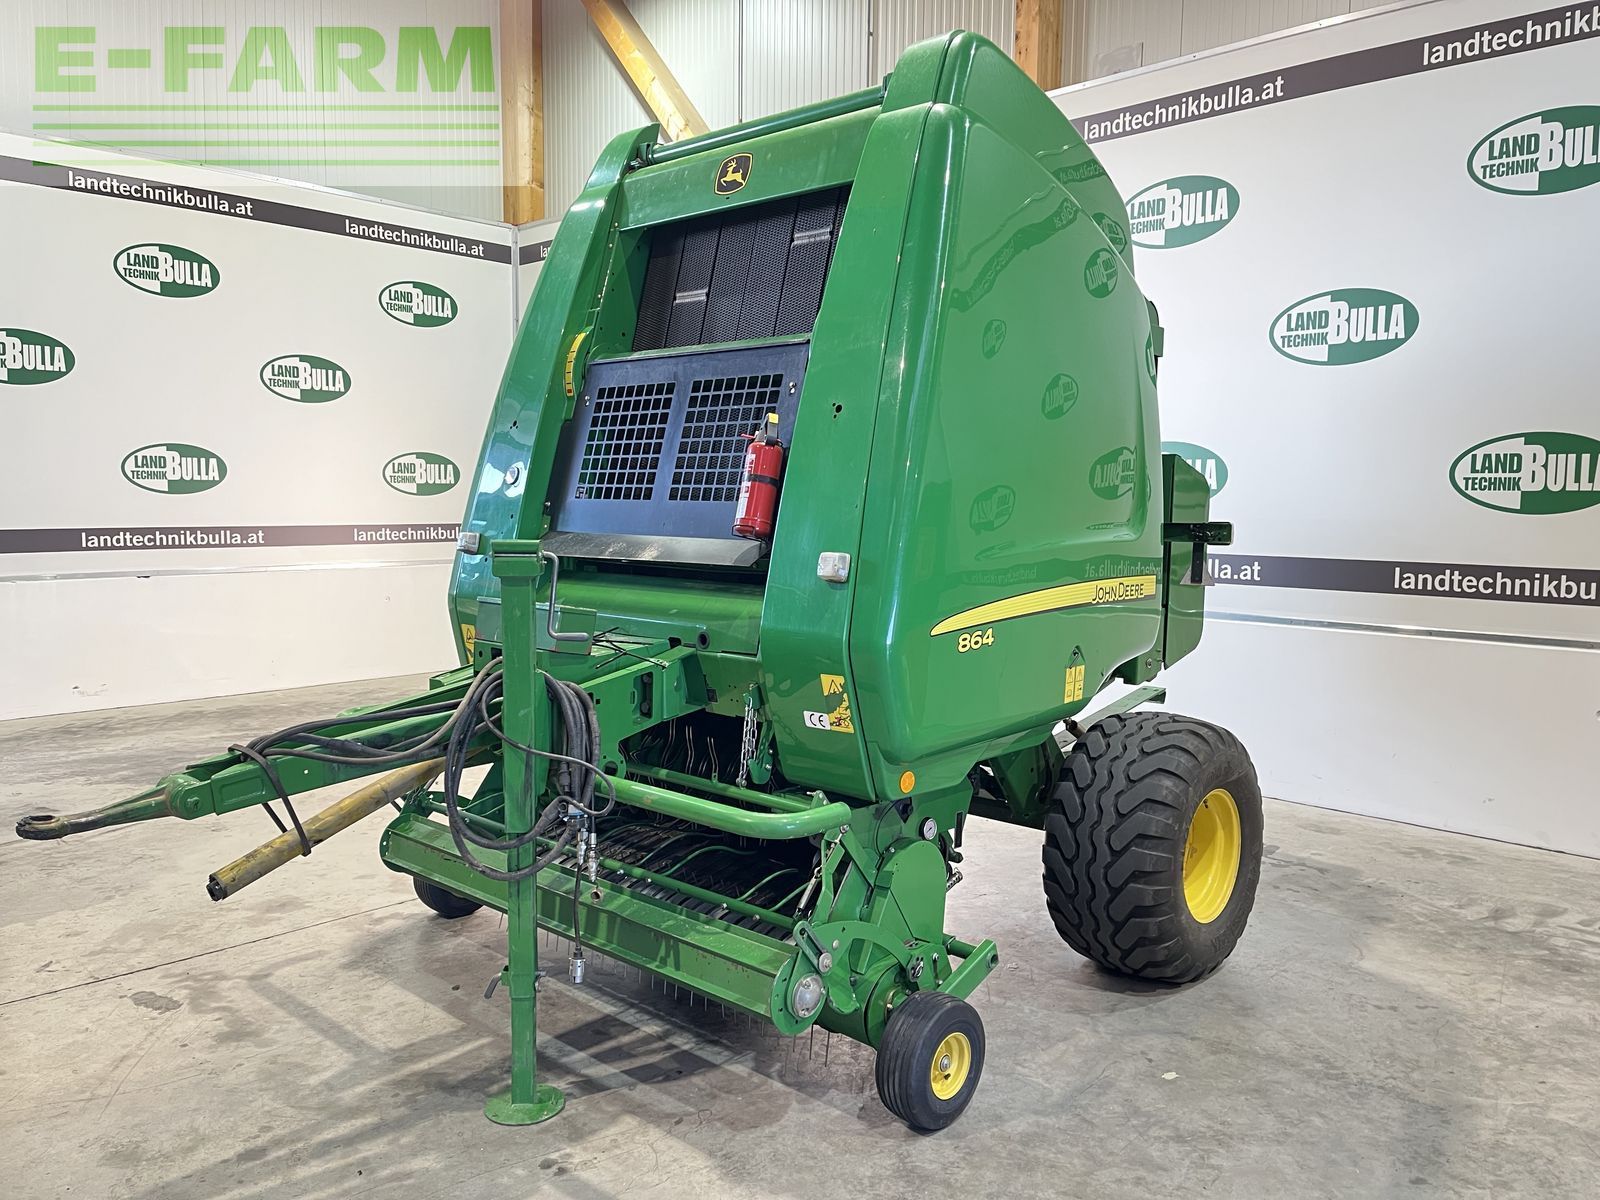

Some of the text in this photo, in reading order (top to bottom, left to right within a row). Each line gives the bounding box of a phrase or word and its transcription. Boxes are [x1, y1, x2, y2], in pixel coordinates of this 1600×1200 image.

[1084, 75, 1285, 141] landtechnikbulla.at
[1487, 132, 1540, 161] LAND
[1540, 121, 1600, 168] BUL
[1480, 156, 1540, 180] TECHNIK
[67, 170, 254, 217] landtechnikbulla.at
[1130, 197, 1166, 221] LAND
[1165, 187, 1229, 227] BULLA
[345, 218, 485, 257] landtechnikbulla.at
[126, 252, 160, 270] LAND
[159, 251, 213, 288] BULLA
[123, 267, 160, 281] TECHNIK
[388, 288, 413, 303] LAND
[413, 287, 453, 318] BULLA
[1286, 309, 1330, 333] LAND
[1328, 300, 1406, 344] BULLA
[1280, 331, 1329, 349] TECHNIK
[6, 336, 67, 372] BULLA
[271, 364, 300, 379] LAND
[299, 361, 345, 393] BULLA
[134, 455, 167, 469] LAND
[166, 450, 220, 481] BULLA
[392, 462, 416, 474] LAND
[416, 458, 455, 484] BULLA
[1470, 452, 1523, 474] LAND
[130, 469, 168, 481] TECHNIK
[1463, 476, 1522, 491] TECHNIK
[81, 529, 265, 548] landtechnikbulla.at
[1091, 582, 1145, 602] JOHN DEERE
[1394, 566, 1597, 600] landtechnikbu
[957, 628, 995, 653] 864
